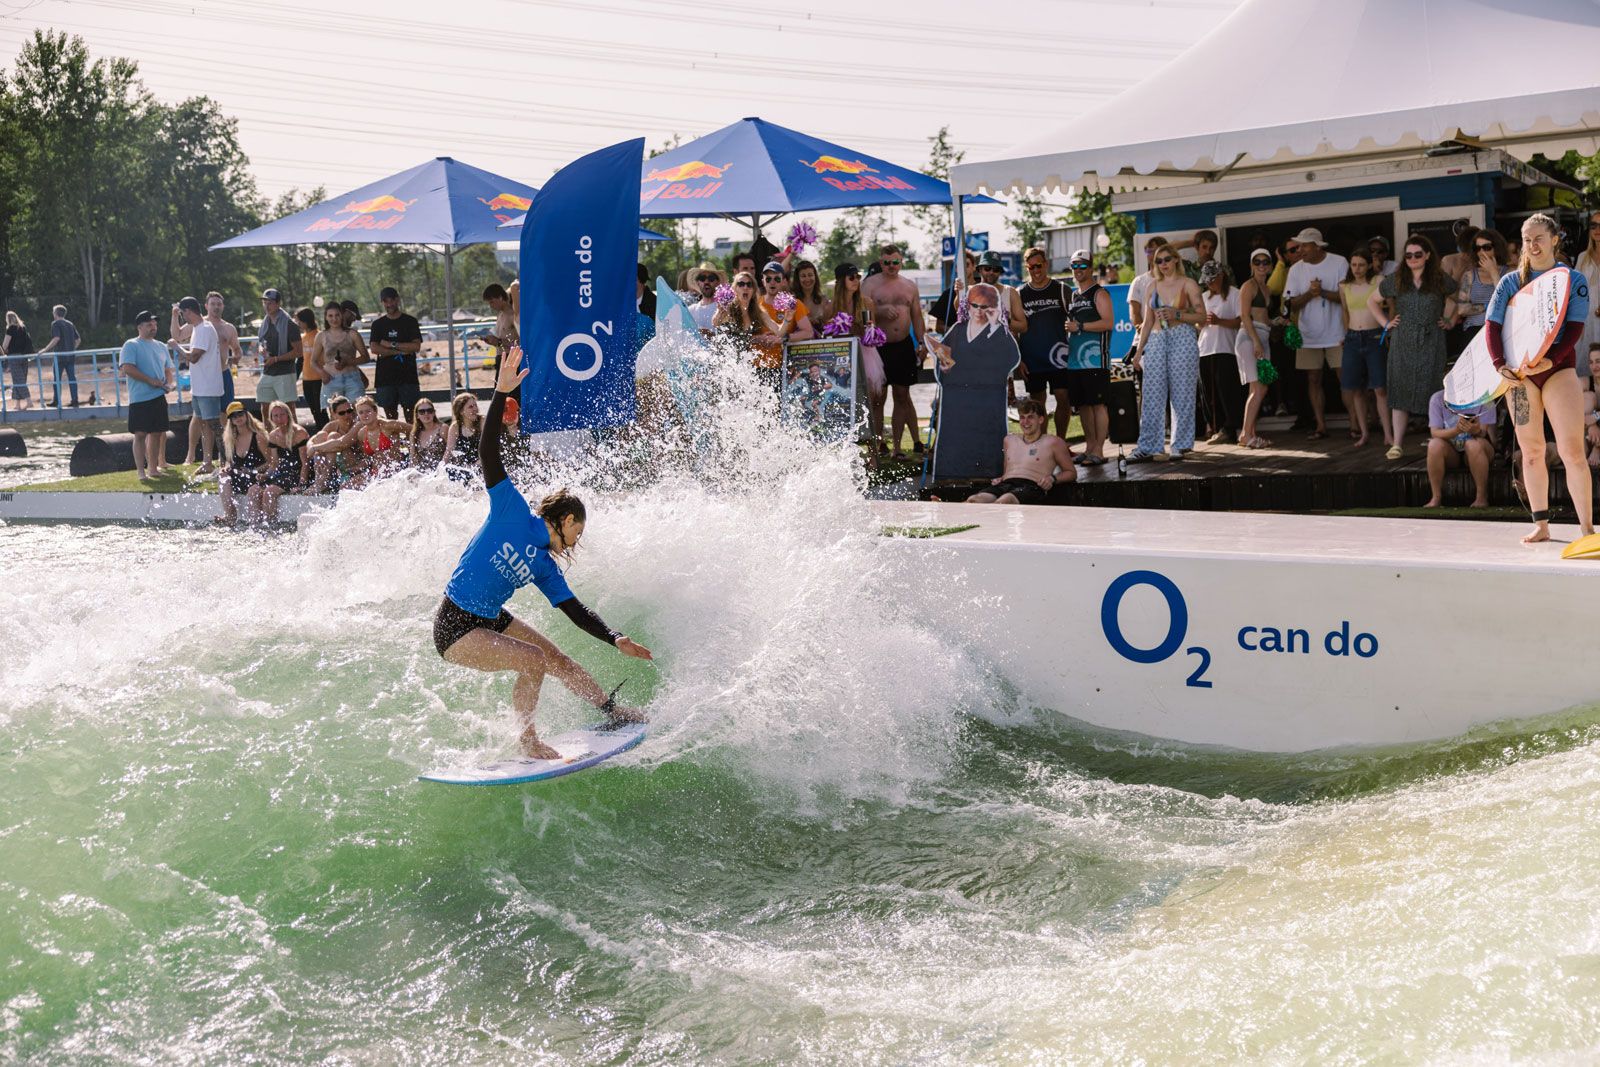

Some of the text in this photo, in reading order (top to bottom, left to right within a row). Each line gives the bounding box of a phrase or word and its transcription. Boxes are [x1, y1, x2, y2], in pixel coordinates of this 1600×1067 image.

[658, 182, 724, 199] Bull
[575, 235, 592, 264] do
[579, 270, 592, 308] can
[1115, 319, 1133, 332] do
[496, 541, 535, 584] SURF
[1101, 570, 1379, 688] O2 can do
